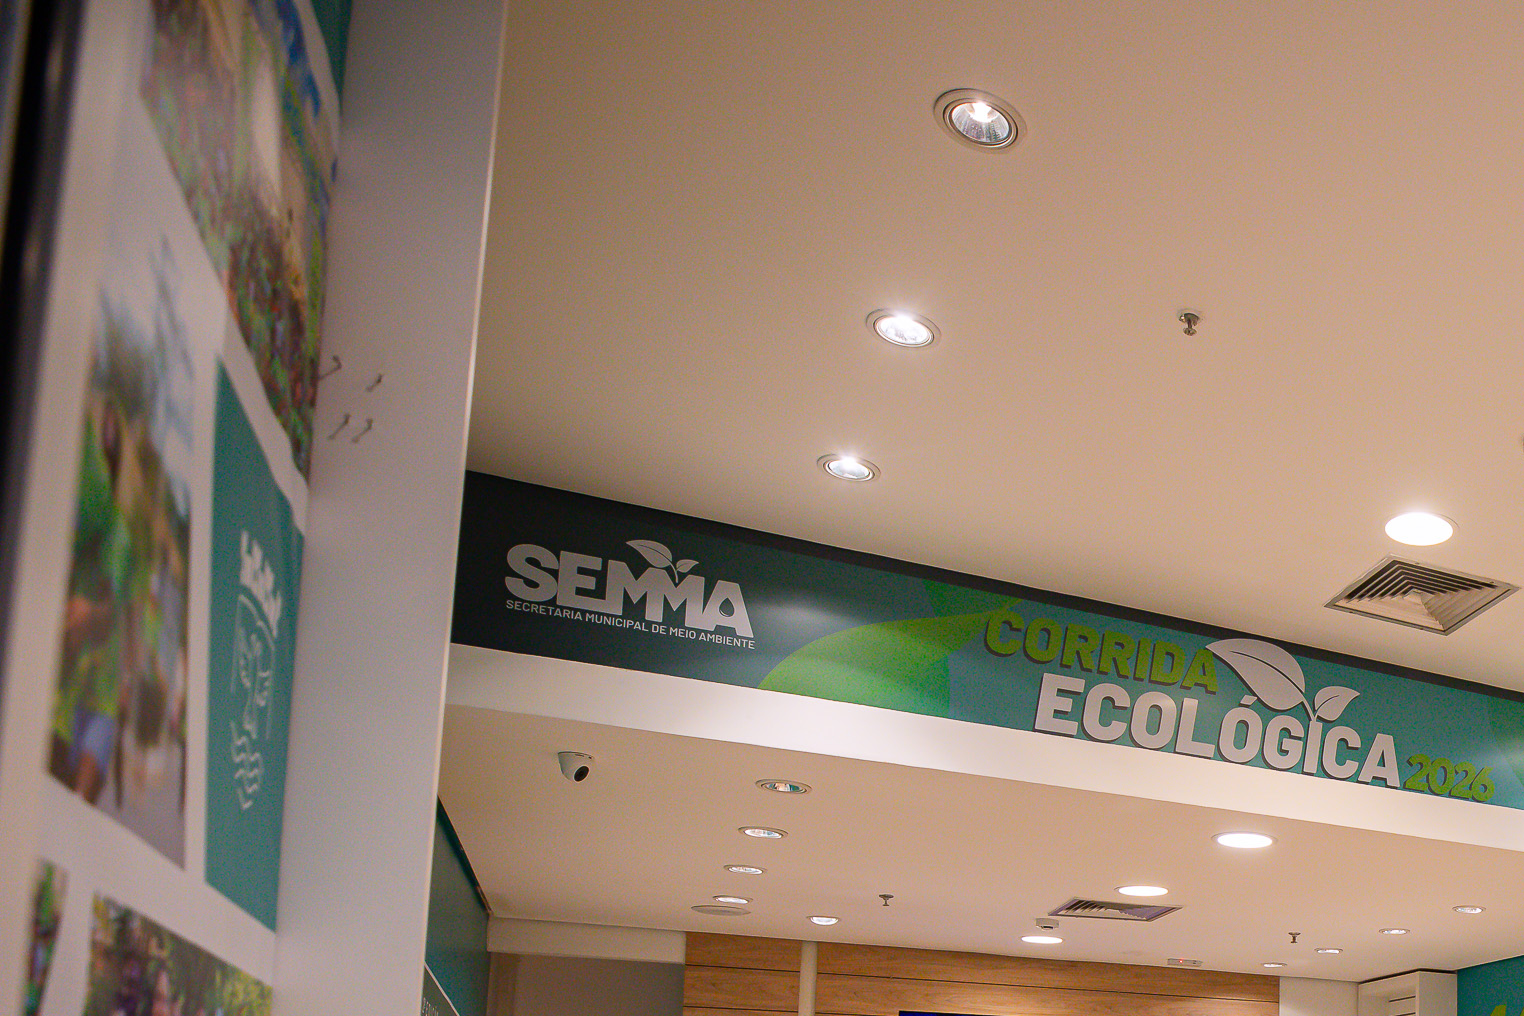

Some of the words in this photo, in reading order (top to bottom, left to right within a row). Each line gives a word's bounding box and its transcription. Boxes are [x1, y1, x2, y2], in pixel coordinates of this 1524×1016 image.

[505, 543, 754, 638] SEMMA
[506, 599, 583, 621] SECRETARIA
[585, 612, 649, 632] MUNICIPAL
[651, 623, 667, 635] DE
[669, 626, 697, 640] MEIO
[699, 632, 756, 650] AMBIENTE
[984, 610, 1219, 694] CORRIDA
[1033, 672, 1401, 788] ECOLÓGICA
[1403, 753, 1497, 801] 2026
